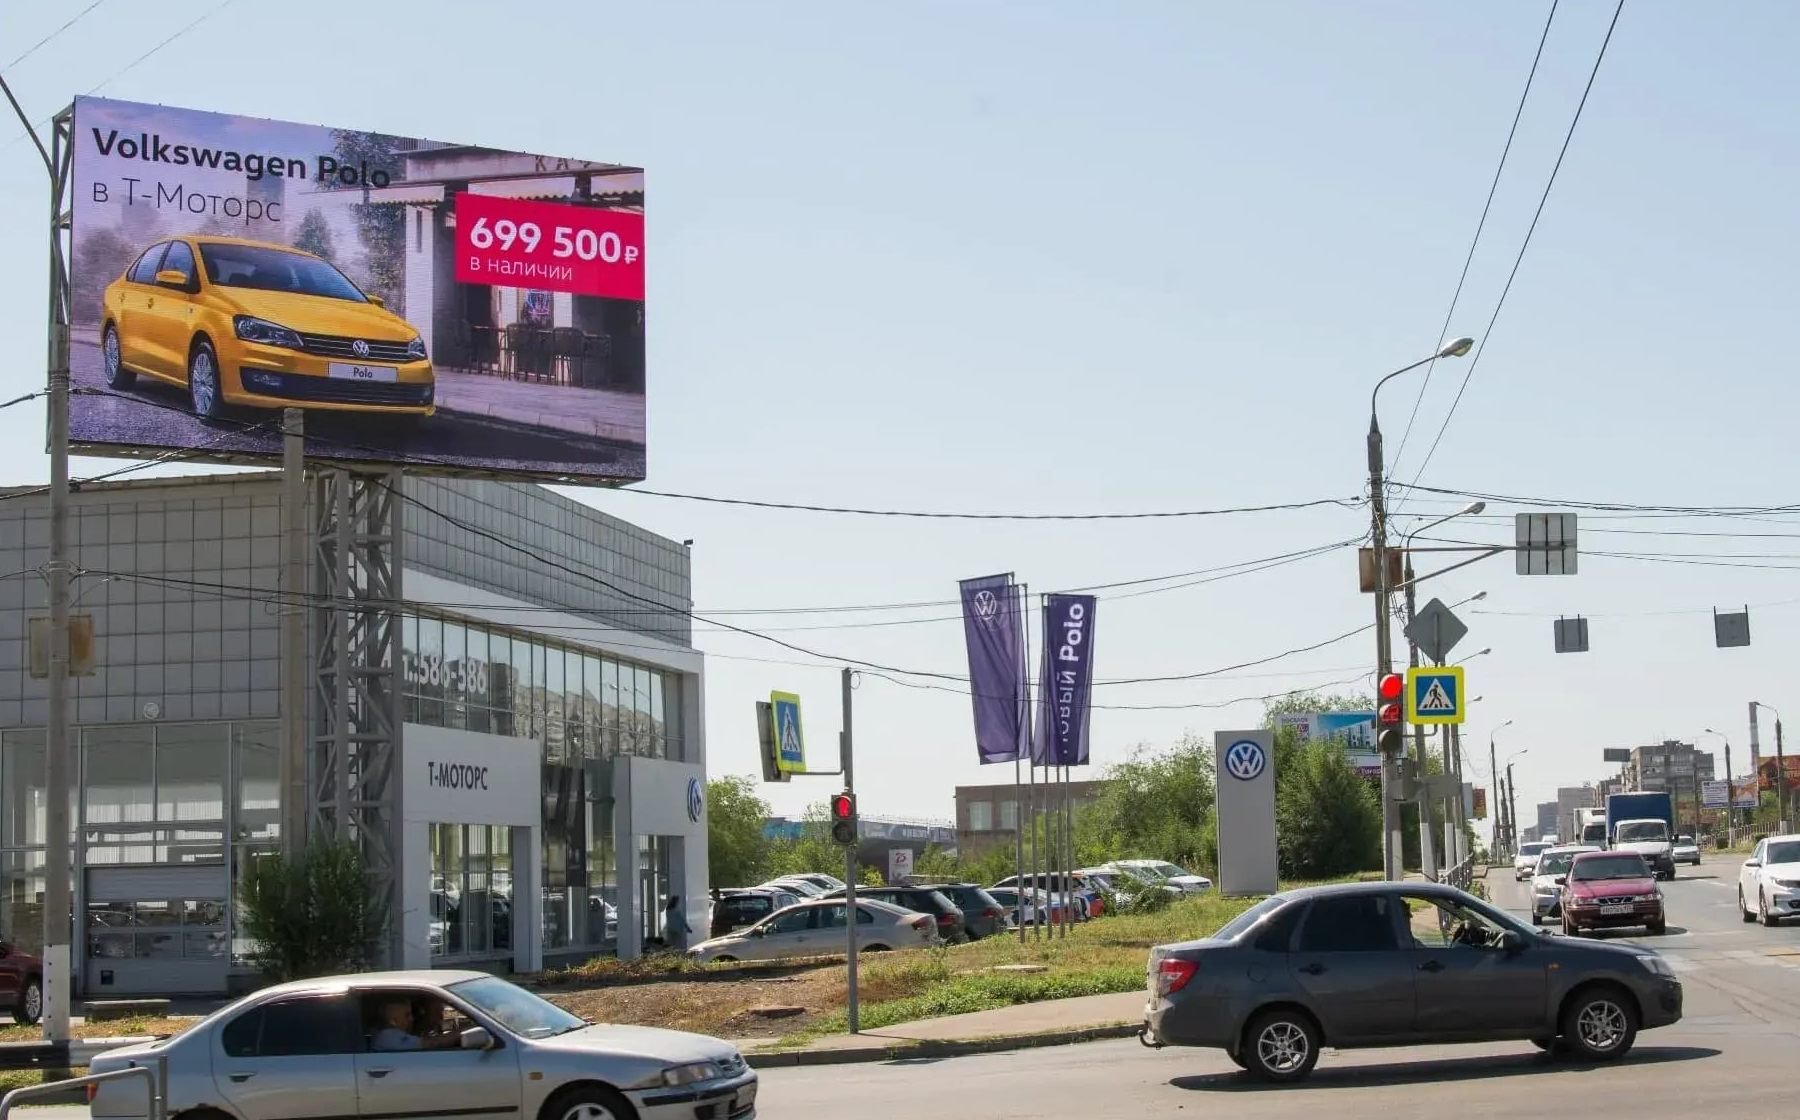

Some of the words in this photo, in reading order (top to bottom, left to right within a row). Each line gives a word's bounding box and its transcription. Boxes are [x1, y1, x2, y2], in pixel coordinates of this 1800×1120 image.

[92, 127, 306, 181] Volkswagen
[318, 155, 391, 188] Polo
[93, 181, 108, 203] в
[121, 177, 281, 226] Т-Моторс
[470, 217, 542, 254] 699
[470, 256, 481, 271] в
[488, 258, 572, 281] наличии
[353, 367, 373, 378] Polo
[1058, 602, 1084, 662] Polo
[428, 761, 488, 791] Т-МОТОРС
